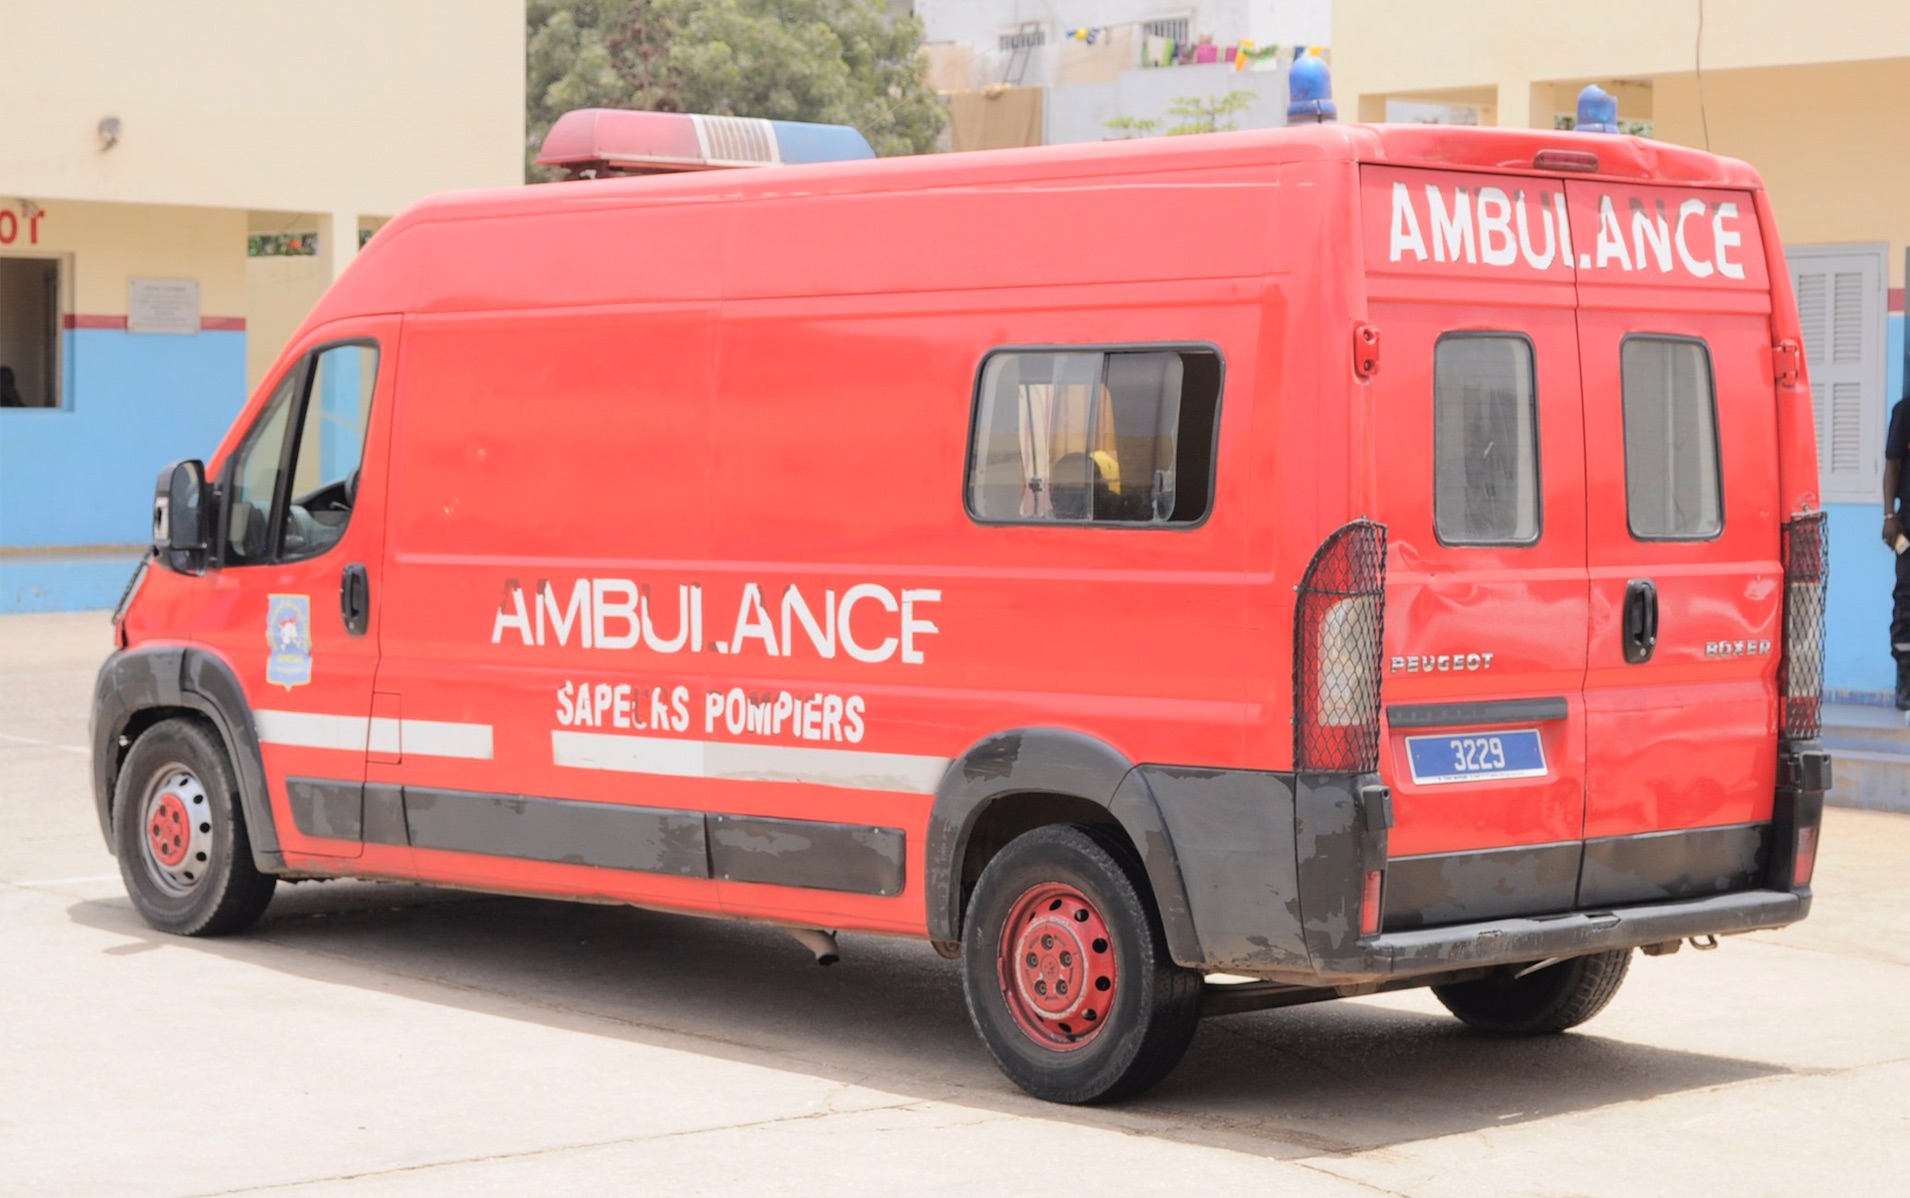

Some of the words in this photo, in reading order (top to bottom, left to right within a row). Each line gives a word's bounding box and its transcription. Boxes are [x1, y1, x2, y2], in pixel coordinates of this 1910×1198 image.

[1389, 182, 1745, 280] AMBULANCE
[491, 578, 943, 664] AMBULANCE
[1391, 653, 1494, 673] PEUGEOT
[1705, 639, 1771, 657] BOXER
[705, 687, 866, 743] POMPIERS
[1450, 737, 1505, 771] 3229
